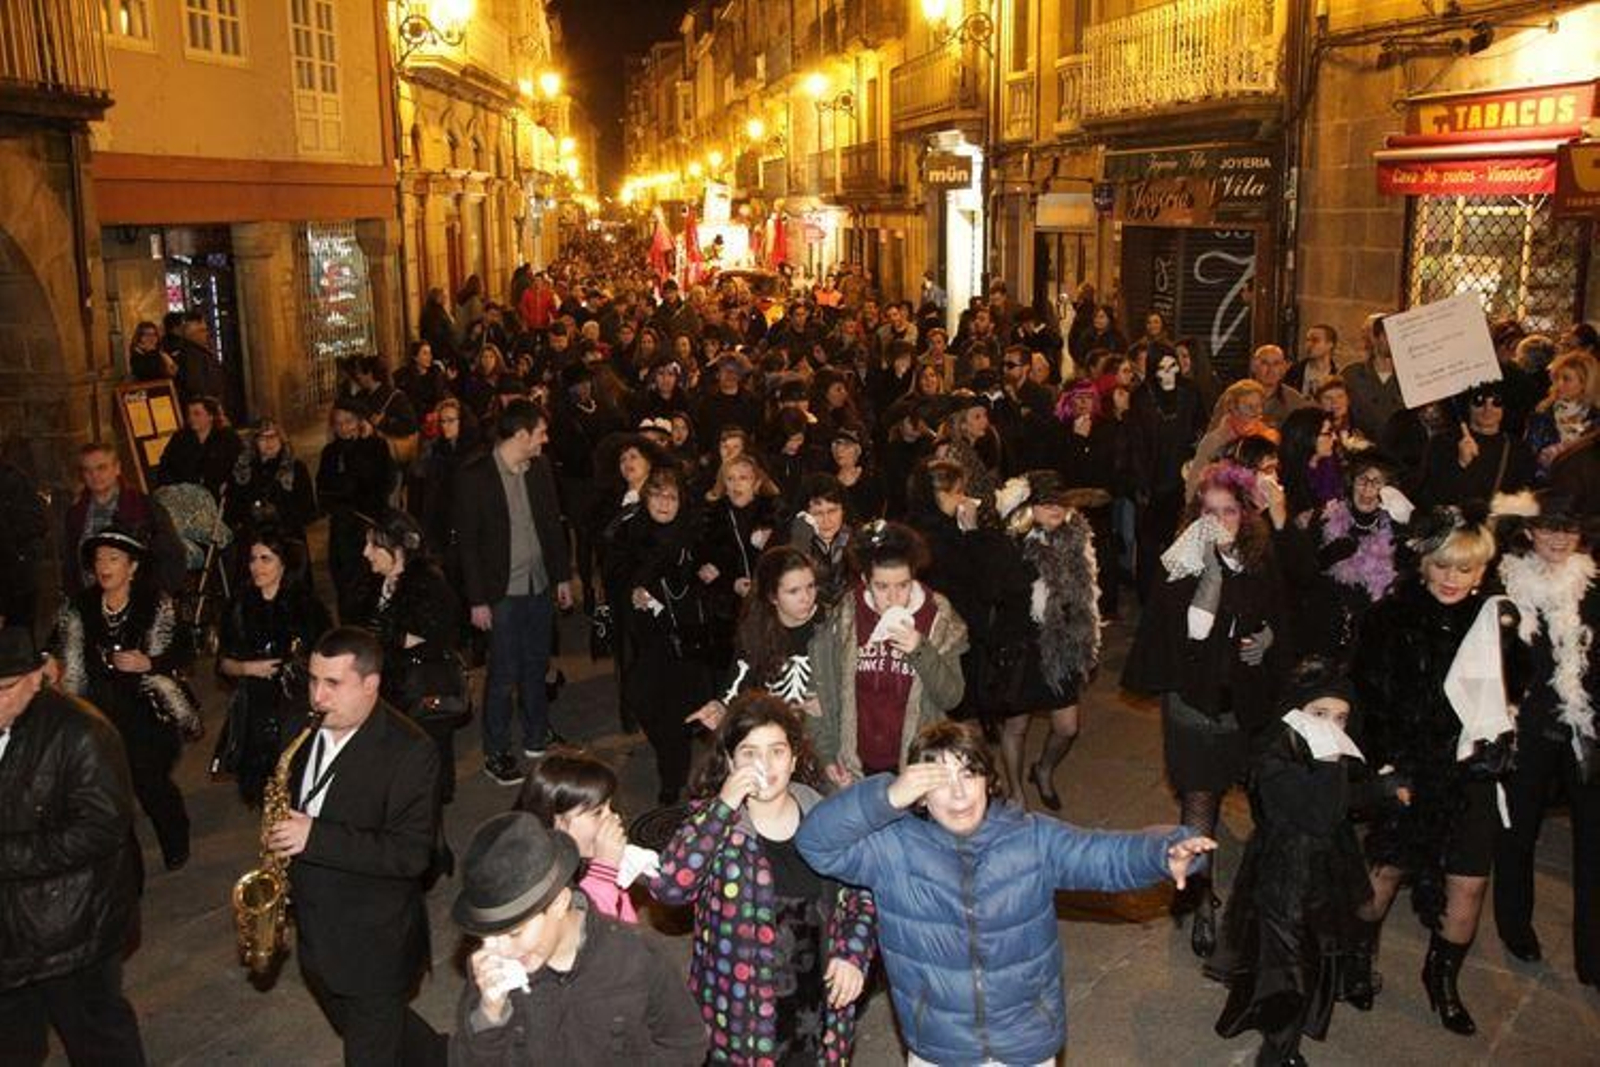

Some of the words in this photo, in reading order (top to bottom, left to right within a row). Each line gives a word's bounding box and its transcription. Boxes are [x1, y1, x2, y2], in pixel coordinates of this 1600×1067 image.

[1456, 95, 1577, 130] TABACOS
[1222, 173, 1266, 198] Vila
[1487, 164, 1545, 183] Vinoteca
